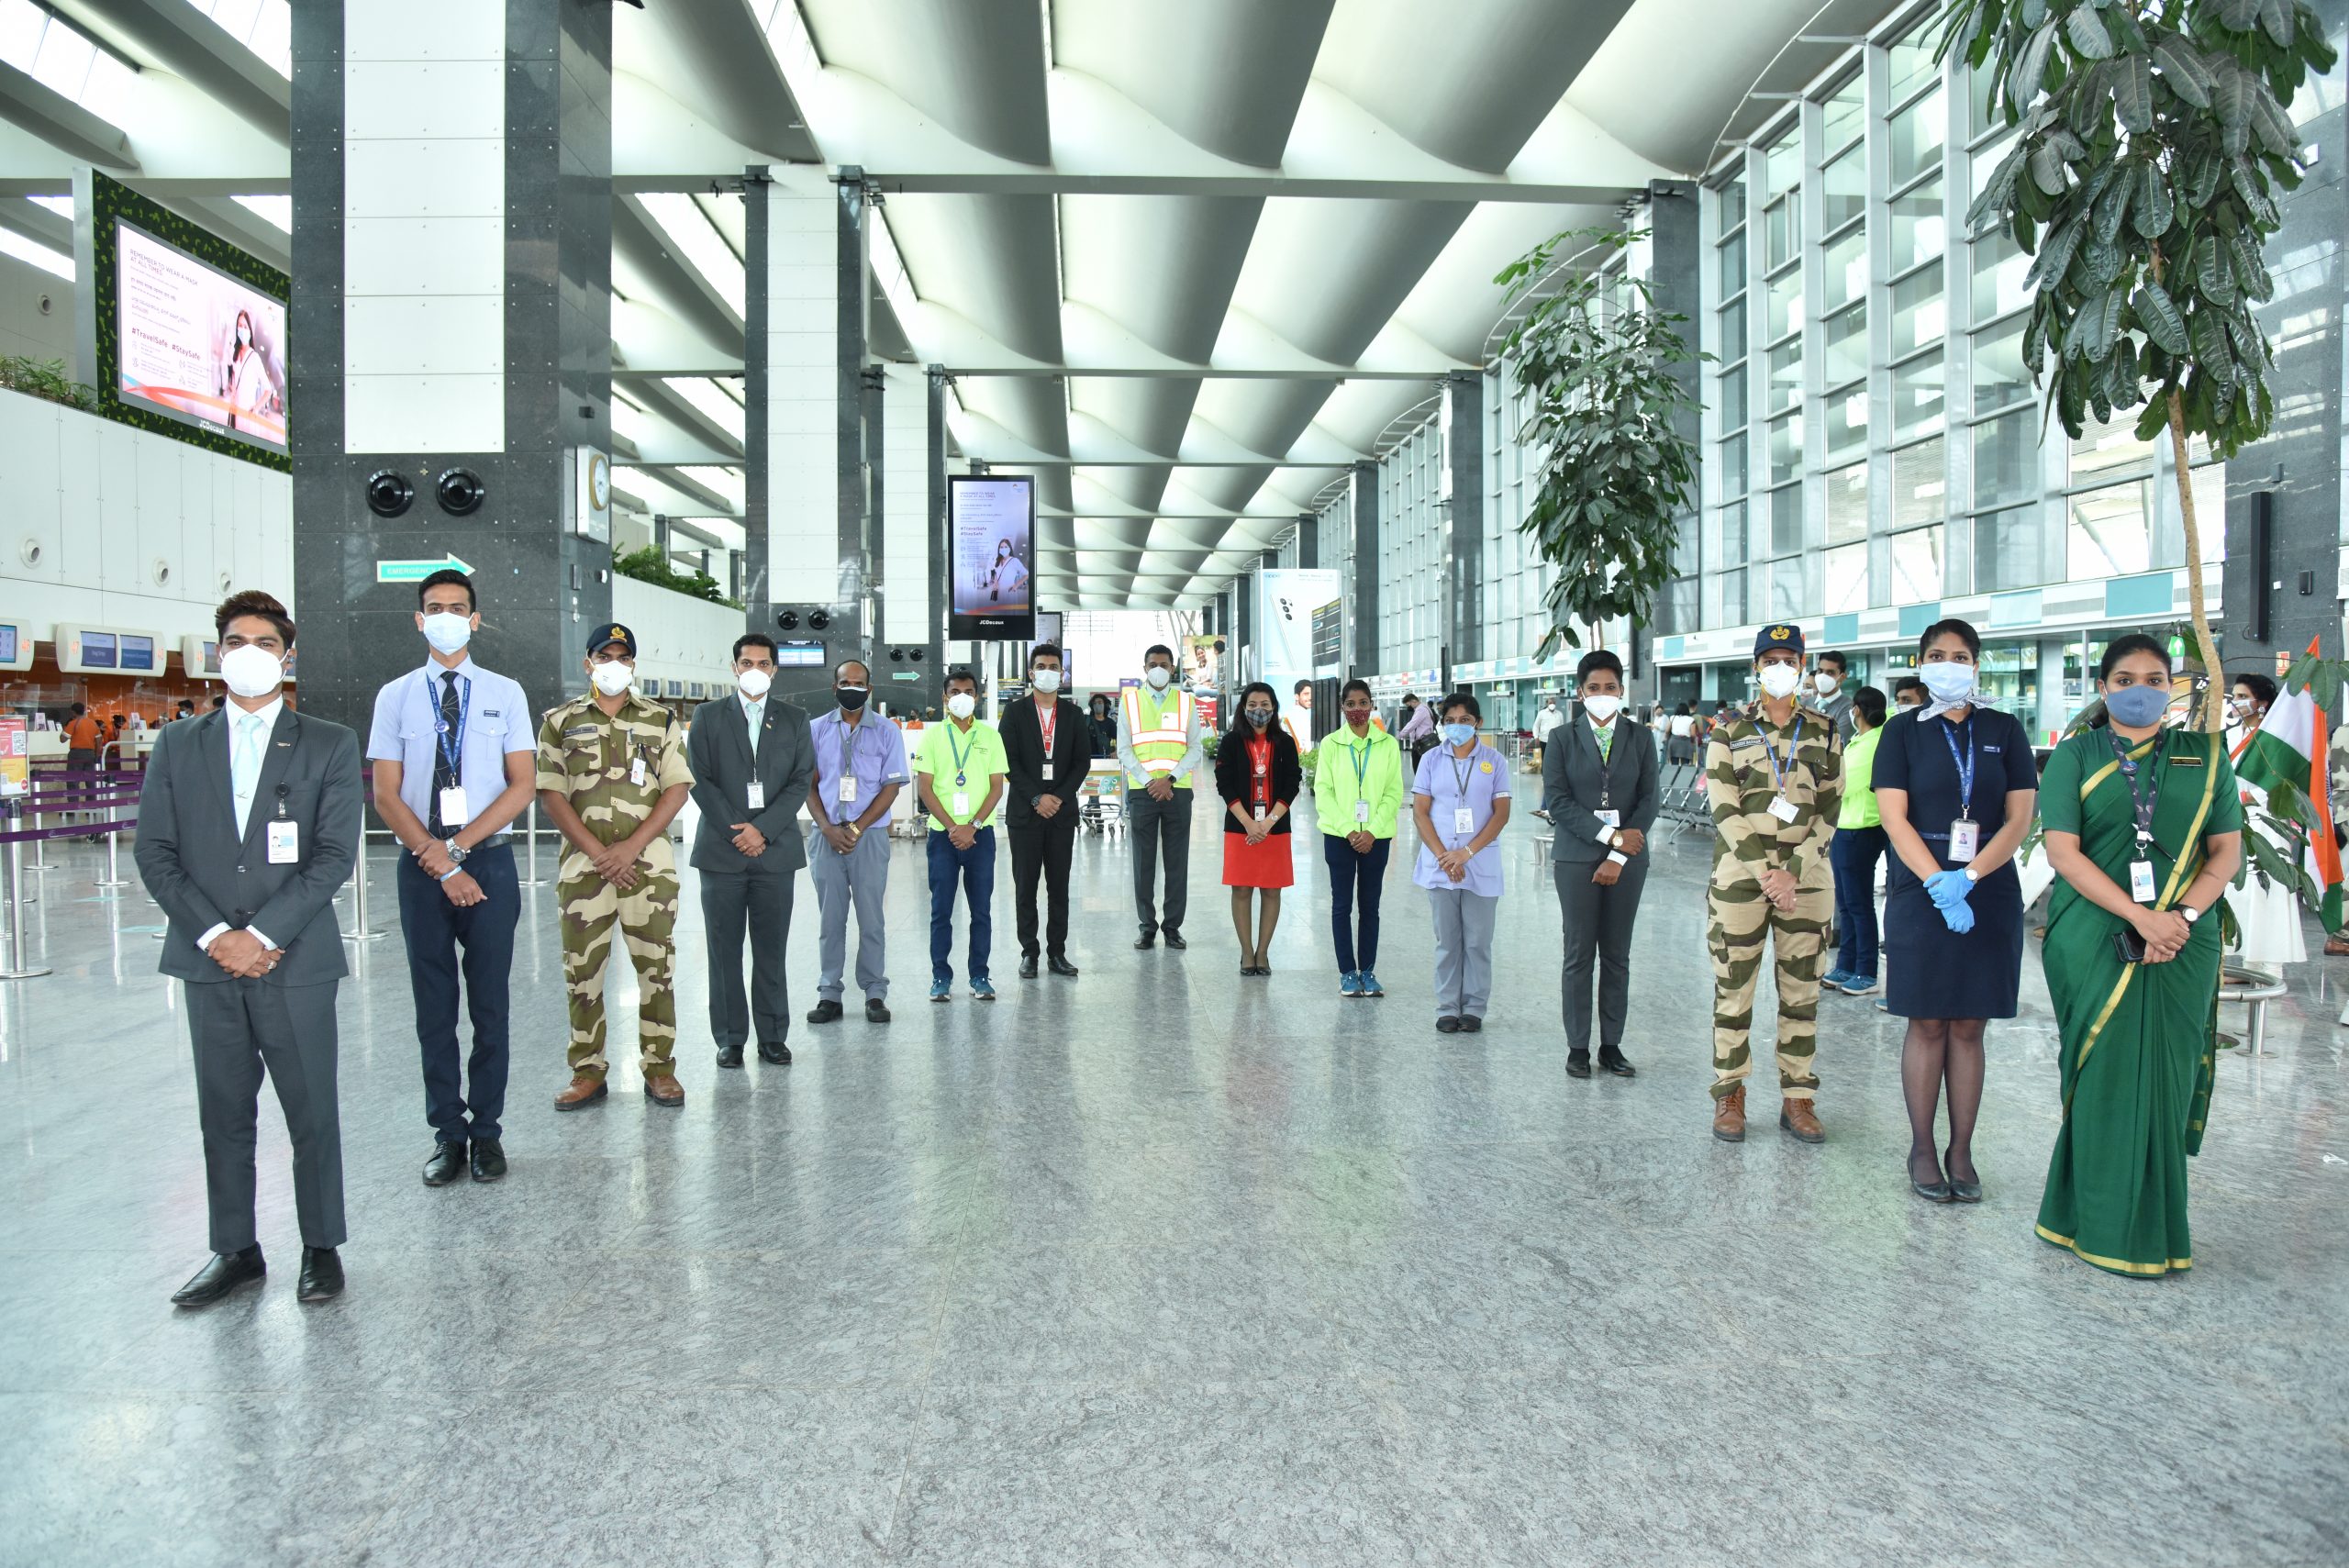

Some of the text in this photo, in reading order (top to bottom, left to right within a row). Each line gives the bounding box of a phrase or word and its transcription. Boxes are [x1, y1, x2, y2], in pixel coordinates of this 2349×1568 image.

[129, 249, 158, 265] REMEMBER
[131, 327, 168, 348] #TravelSafe
[172, 344, 201, 361] #StaySafe
[199, 419, 225, 435] JCDecaux
